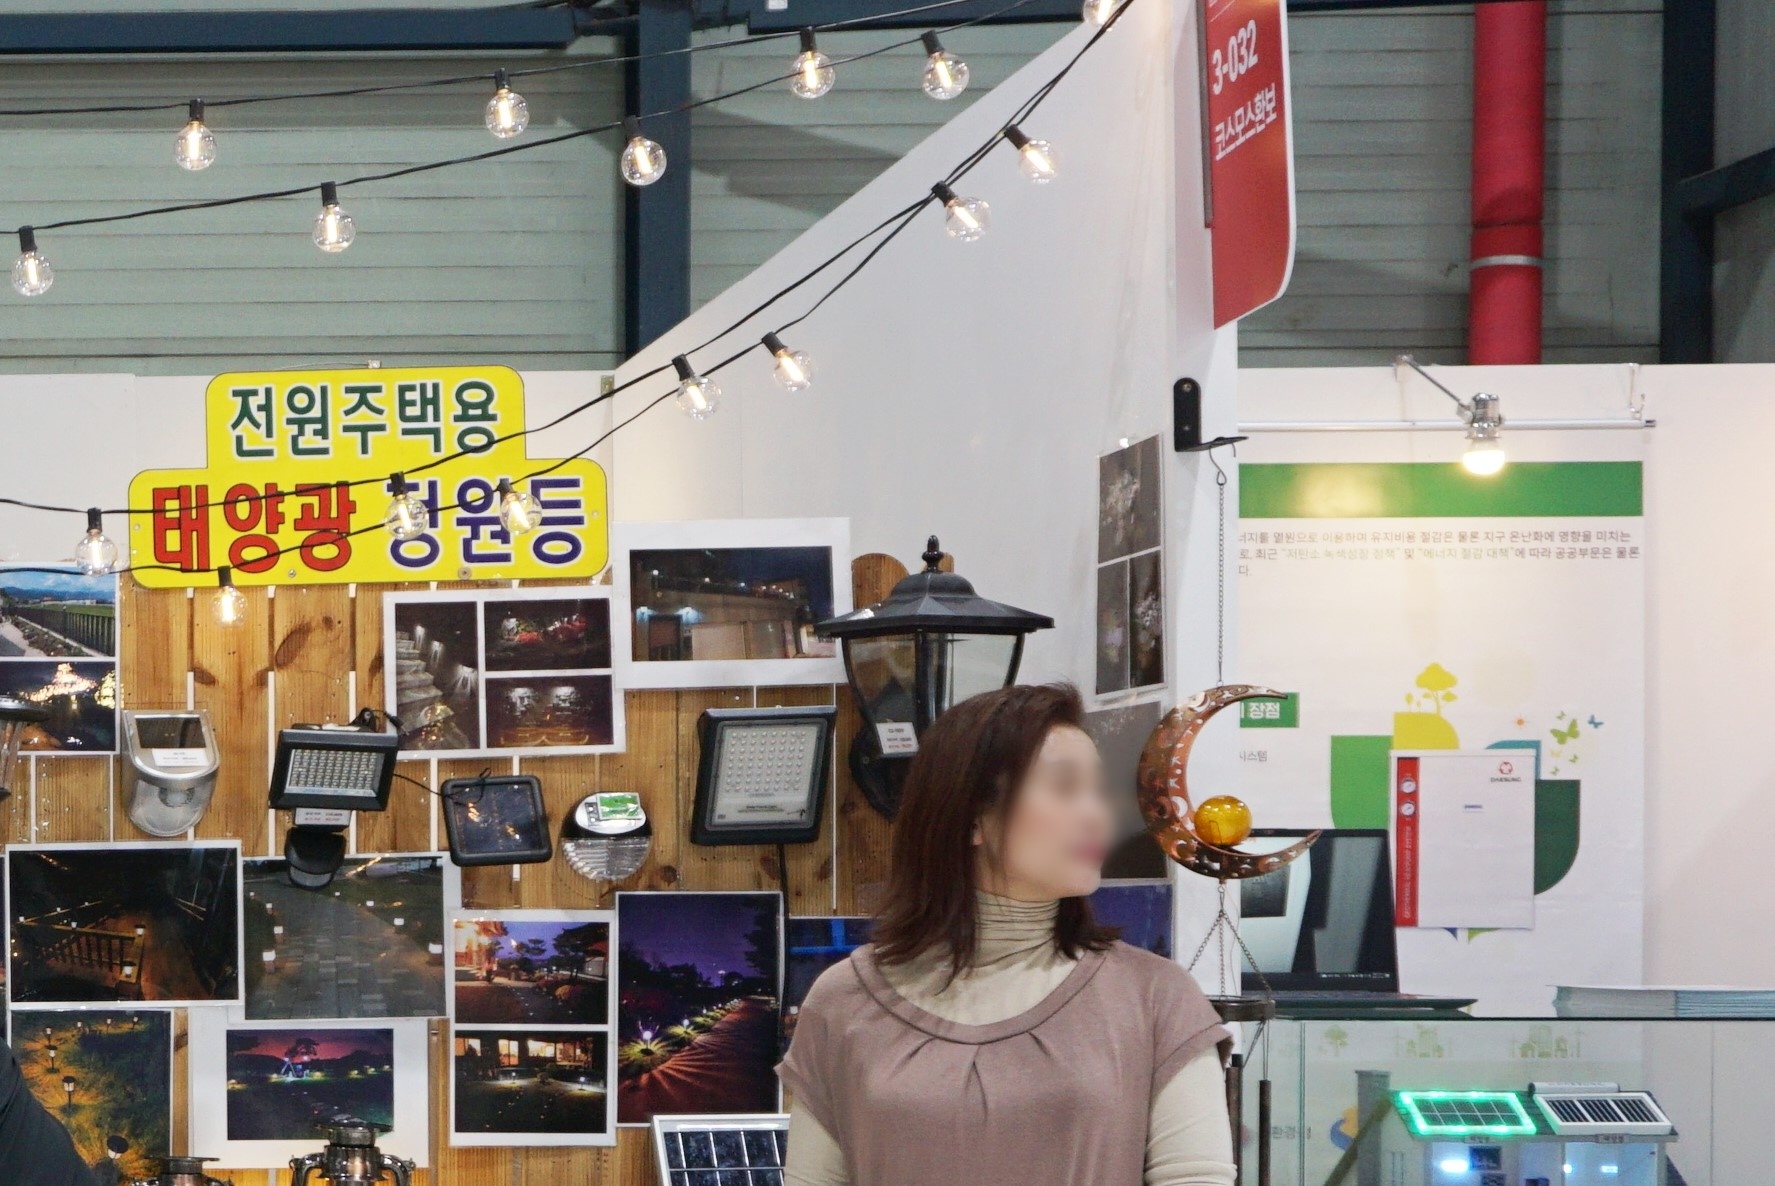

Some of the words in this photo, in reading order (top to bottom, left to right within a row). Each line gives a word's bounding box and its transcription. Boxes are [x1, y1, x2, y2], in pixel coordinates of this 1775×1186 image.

[1212, 19, 1259, 96] 3-032
[1215, 81, 1278, 162] 코스모스환보
[229, 379, 500, 458] 전원주택용
[151, 480, 358, 574] 태양광
[386, 476, 586, 569] 정원등
[1255, 549, 1278, 560] 최근
[1529, 547, 1552, 559] 따라
[1555, 547, 1612, 559] 공공부문은
[1616, 547, 1640, 559] 물론
[1273, 532, 1319, 544] 열원으로
[1322, 532, 1367, 544] 이용하며
[1371, 532, 1416, 544] 유지비용
[1420, 531, 1453, 543] 절감은
[1458, 531, 1481, 543] 물론
[1484, 531, 1506, 543] 지구
[1509, 531, 1555, 543] 온난화에
[1558, 531, 1592, 543] 영향을
[1596, 531, 1631, 543] 미치는
[1249, 702, 1281, 719] 장점
